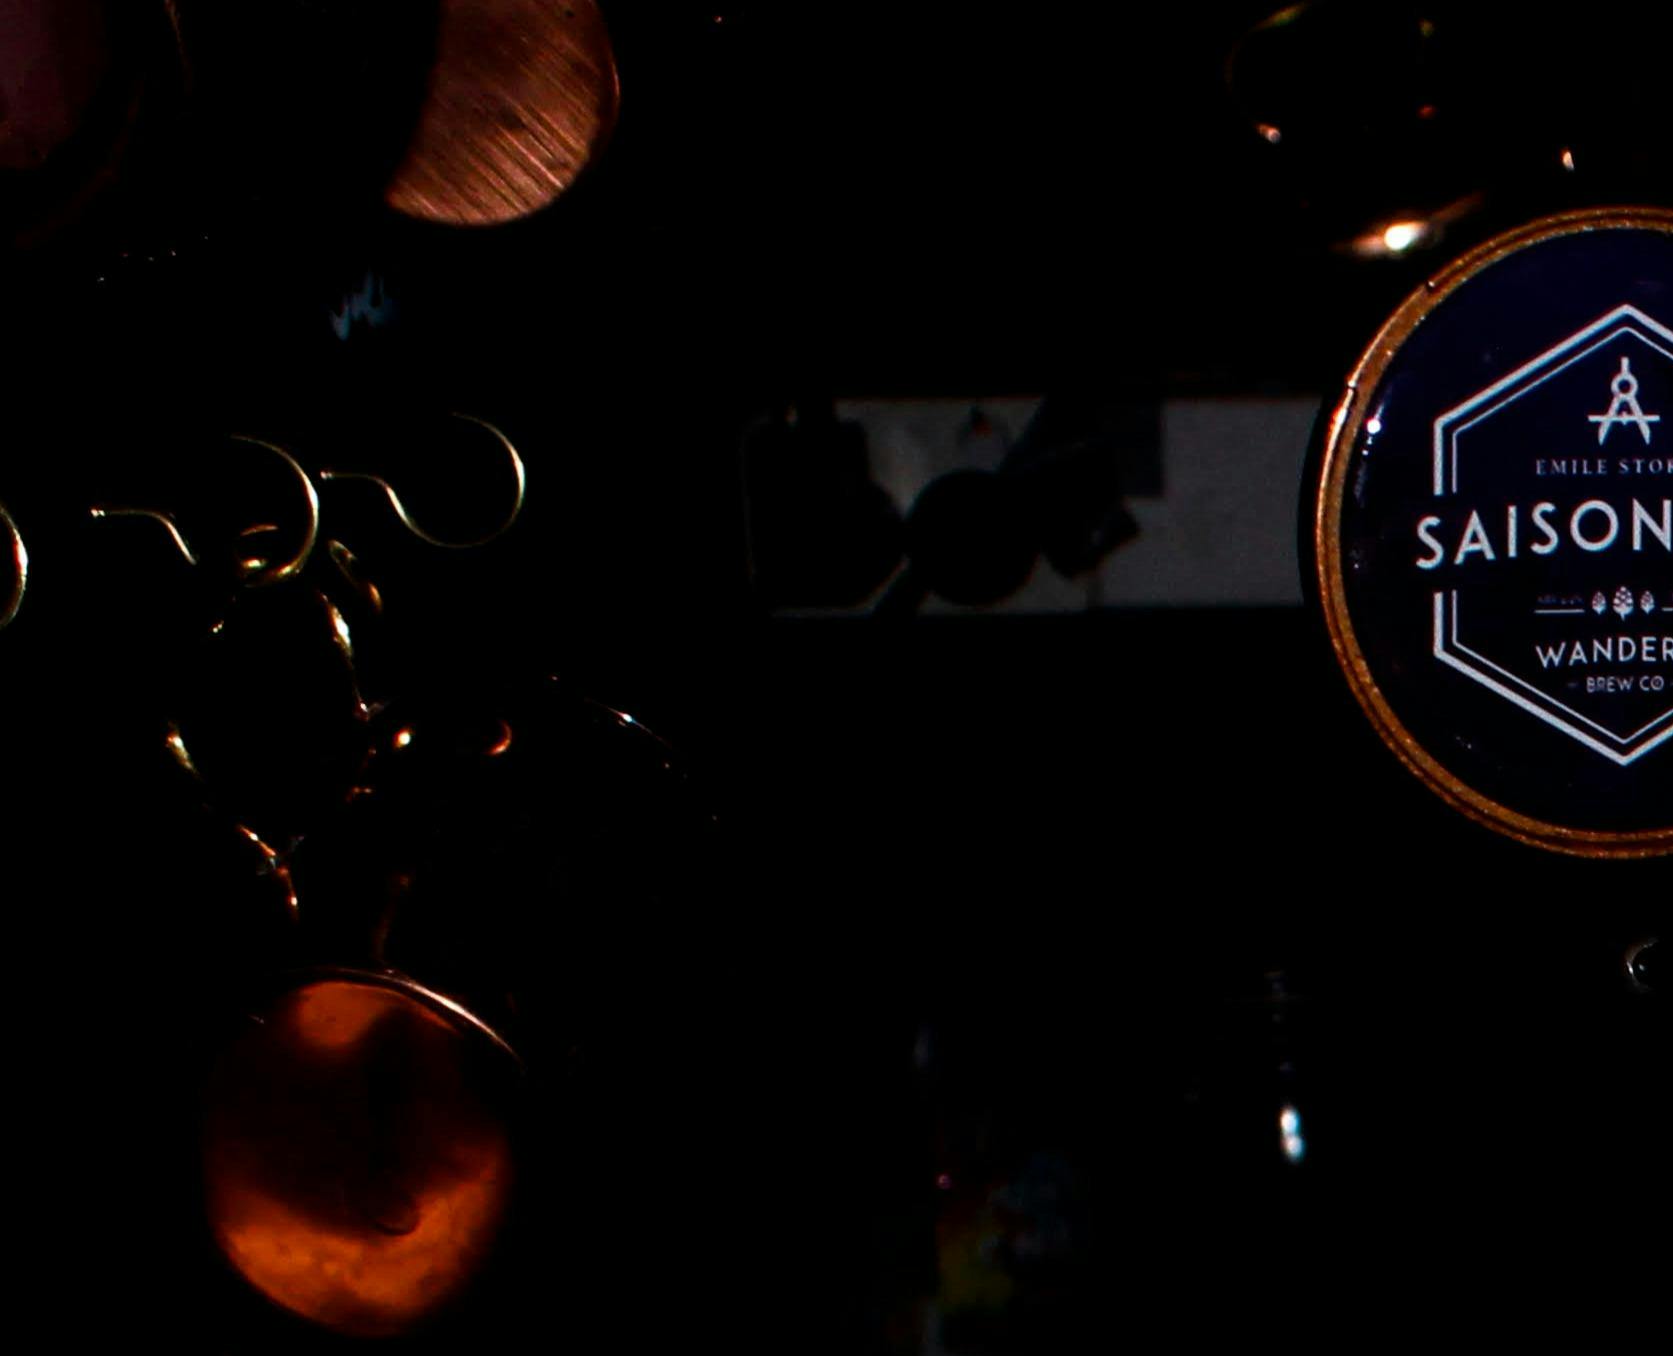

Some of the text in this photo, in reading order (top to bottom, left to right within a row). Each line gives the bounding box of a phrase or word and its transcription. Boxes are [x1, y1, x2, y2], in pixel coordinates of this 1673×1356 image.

[1535, 458, 1608, 477] EMILE
[1416, 499, 1673, 570] SAISON
[1586, 675, 1665, 694] BREW CO
